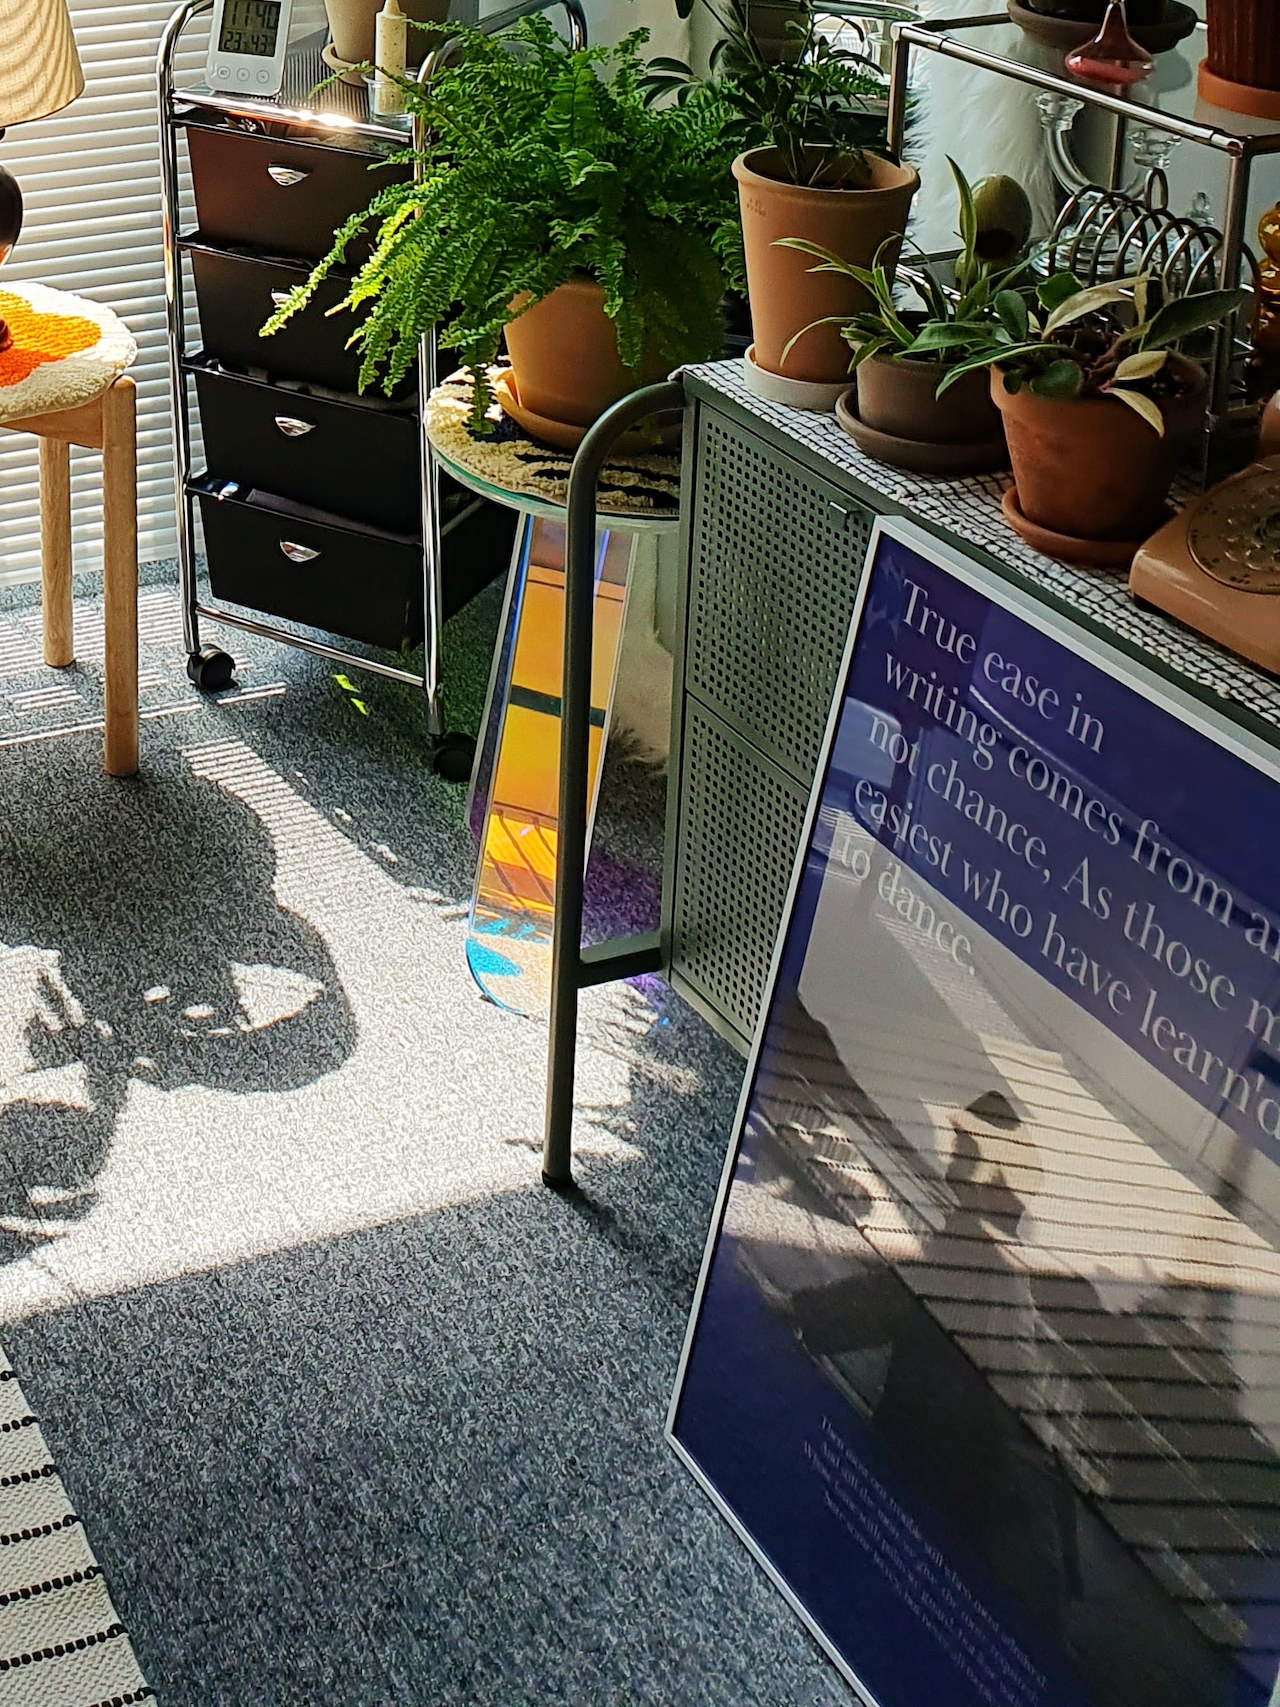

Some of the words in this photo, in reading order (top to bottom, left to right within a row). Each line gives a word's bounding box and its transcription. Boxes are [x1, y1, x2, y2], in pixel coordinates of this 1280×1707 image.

[901, 578, 978, 665] True
[983, 650, 1061, 720] ease
[1066, 693, 1106, 754] in
[842, 839, 871, 881] to
[877, 860, 977, 976] dance.
[854, 777, 954, 878] easiest
[963, 858, 1034, 939] who
[1042, 911, 1132, 1016] have
[869, 715, 922, 777] not
[927, 758, 1052, 884] chance,
[1062, 855, 1112, 921] As
[1123, 900, 1236, 1011] those
[885, 652, 1003, 771] writing
[1008, 744, 1124, 846] comes
[1129, 818, 1237, 927] from
